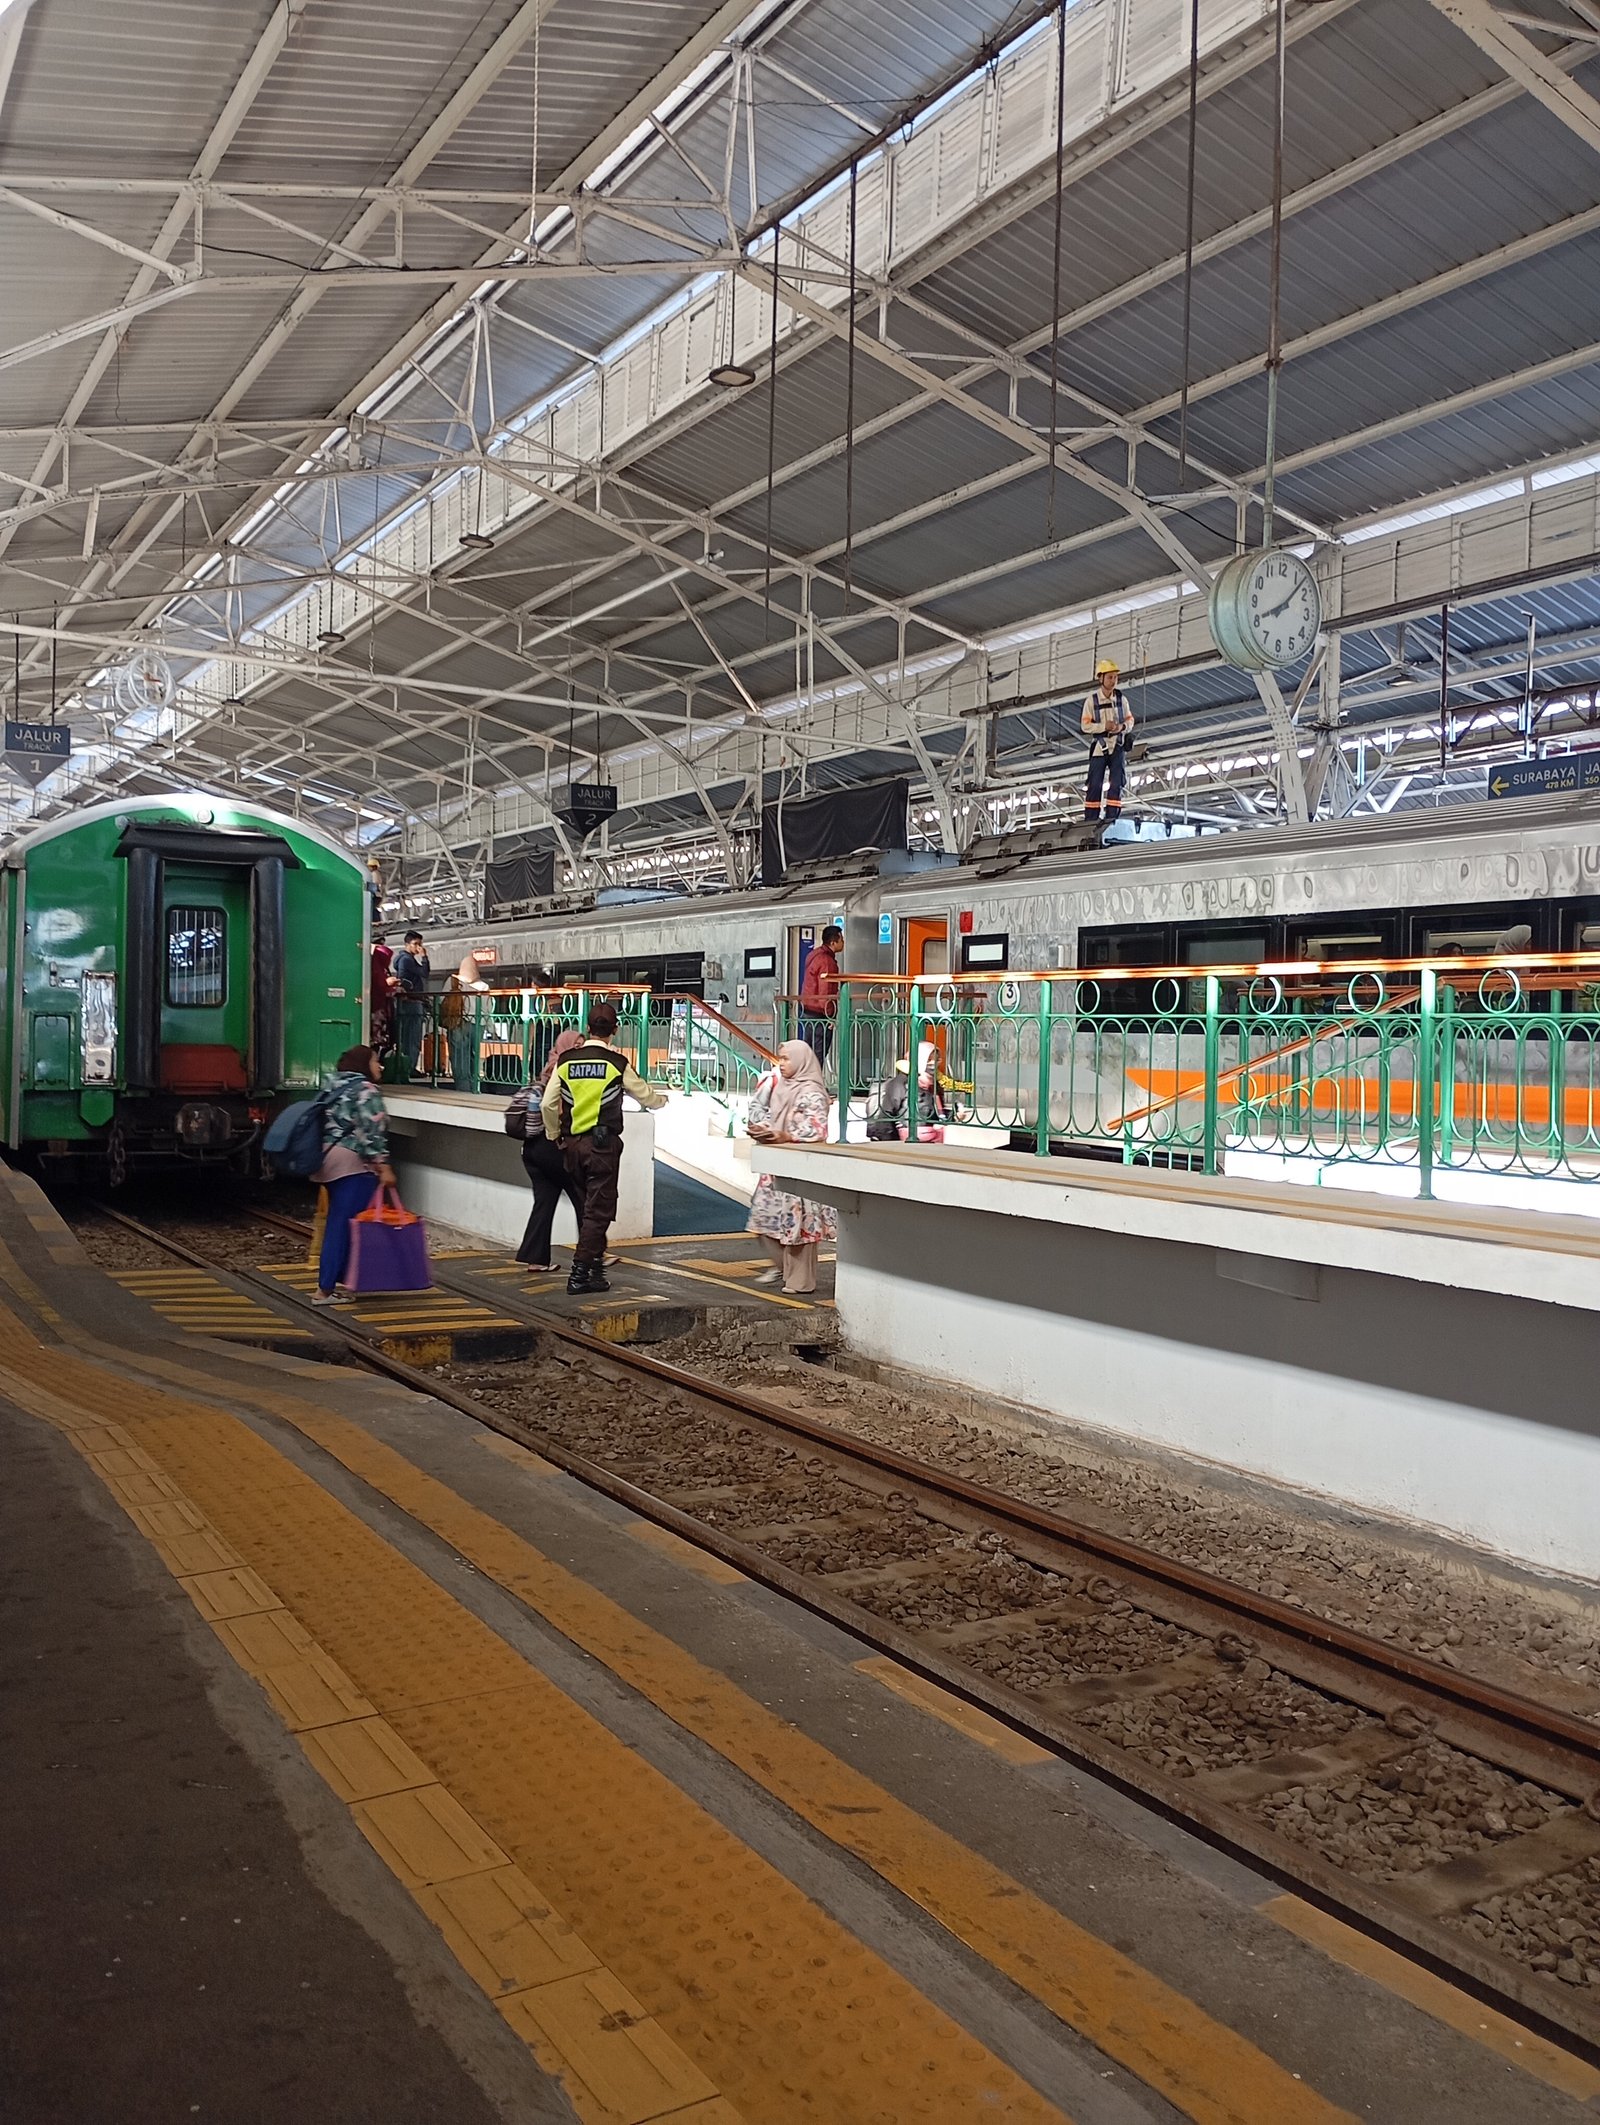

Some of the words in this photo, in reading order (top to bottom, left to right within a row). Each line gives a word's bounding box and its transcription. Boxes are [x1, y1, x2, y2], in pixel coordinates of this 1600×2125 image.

[1266, 560, 1274, 578] 11
[1278, 561, 1288, 577] 12
[1255, 576, 1264, 590] 10
[1251, 594, 1258, 608] 9
[1301, 588, 1308, 602] 2
[1253, 614, 1260, 628] 8
[1303, 608, 1310, 621] 3
[1263, 630, 1270, 644] 7
[1298, 626, 1306, 639] 4
[1275, 639, 1282, 653] 6
[1288, 637, 1295, 651] 5
[14, 728, 62, 743] JALUR
[23, 742, 53, 751] TRACK
[29, 759, 42, 774] 1
[1513, 766, 1576, 785] SURABAYA
[1560, 778, 1575, 788] KM
[577, 788, 611, 799] JALUR
[585, 813, 597, 826] 2
[739, 988, 745, 1001] 4
[1006, 984, 1014, 999] 3
[570, 1064, 605, 1077] SATPAM
